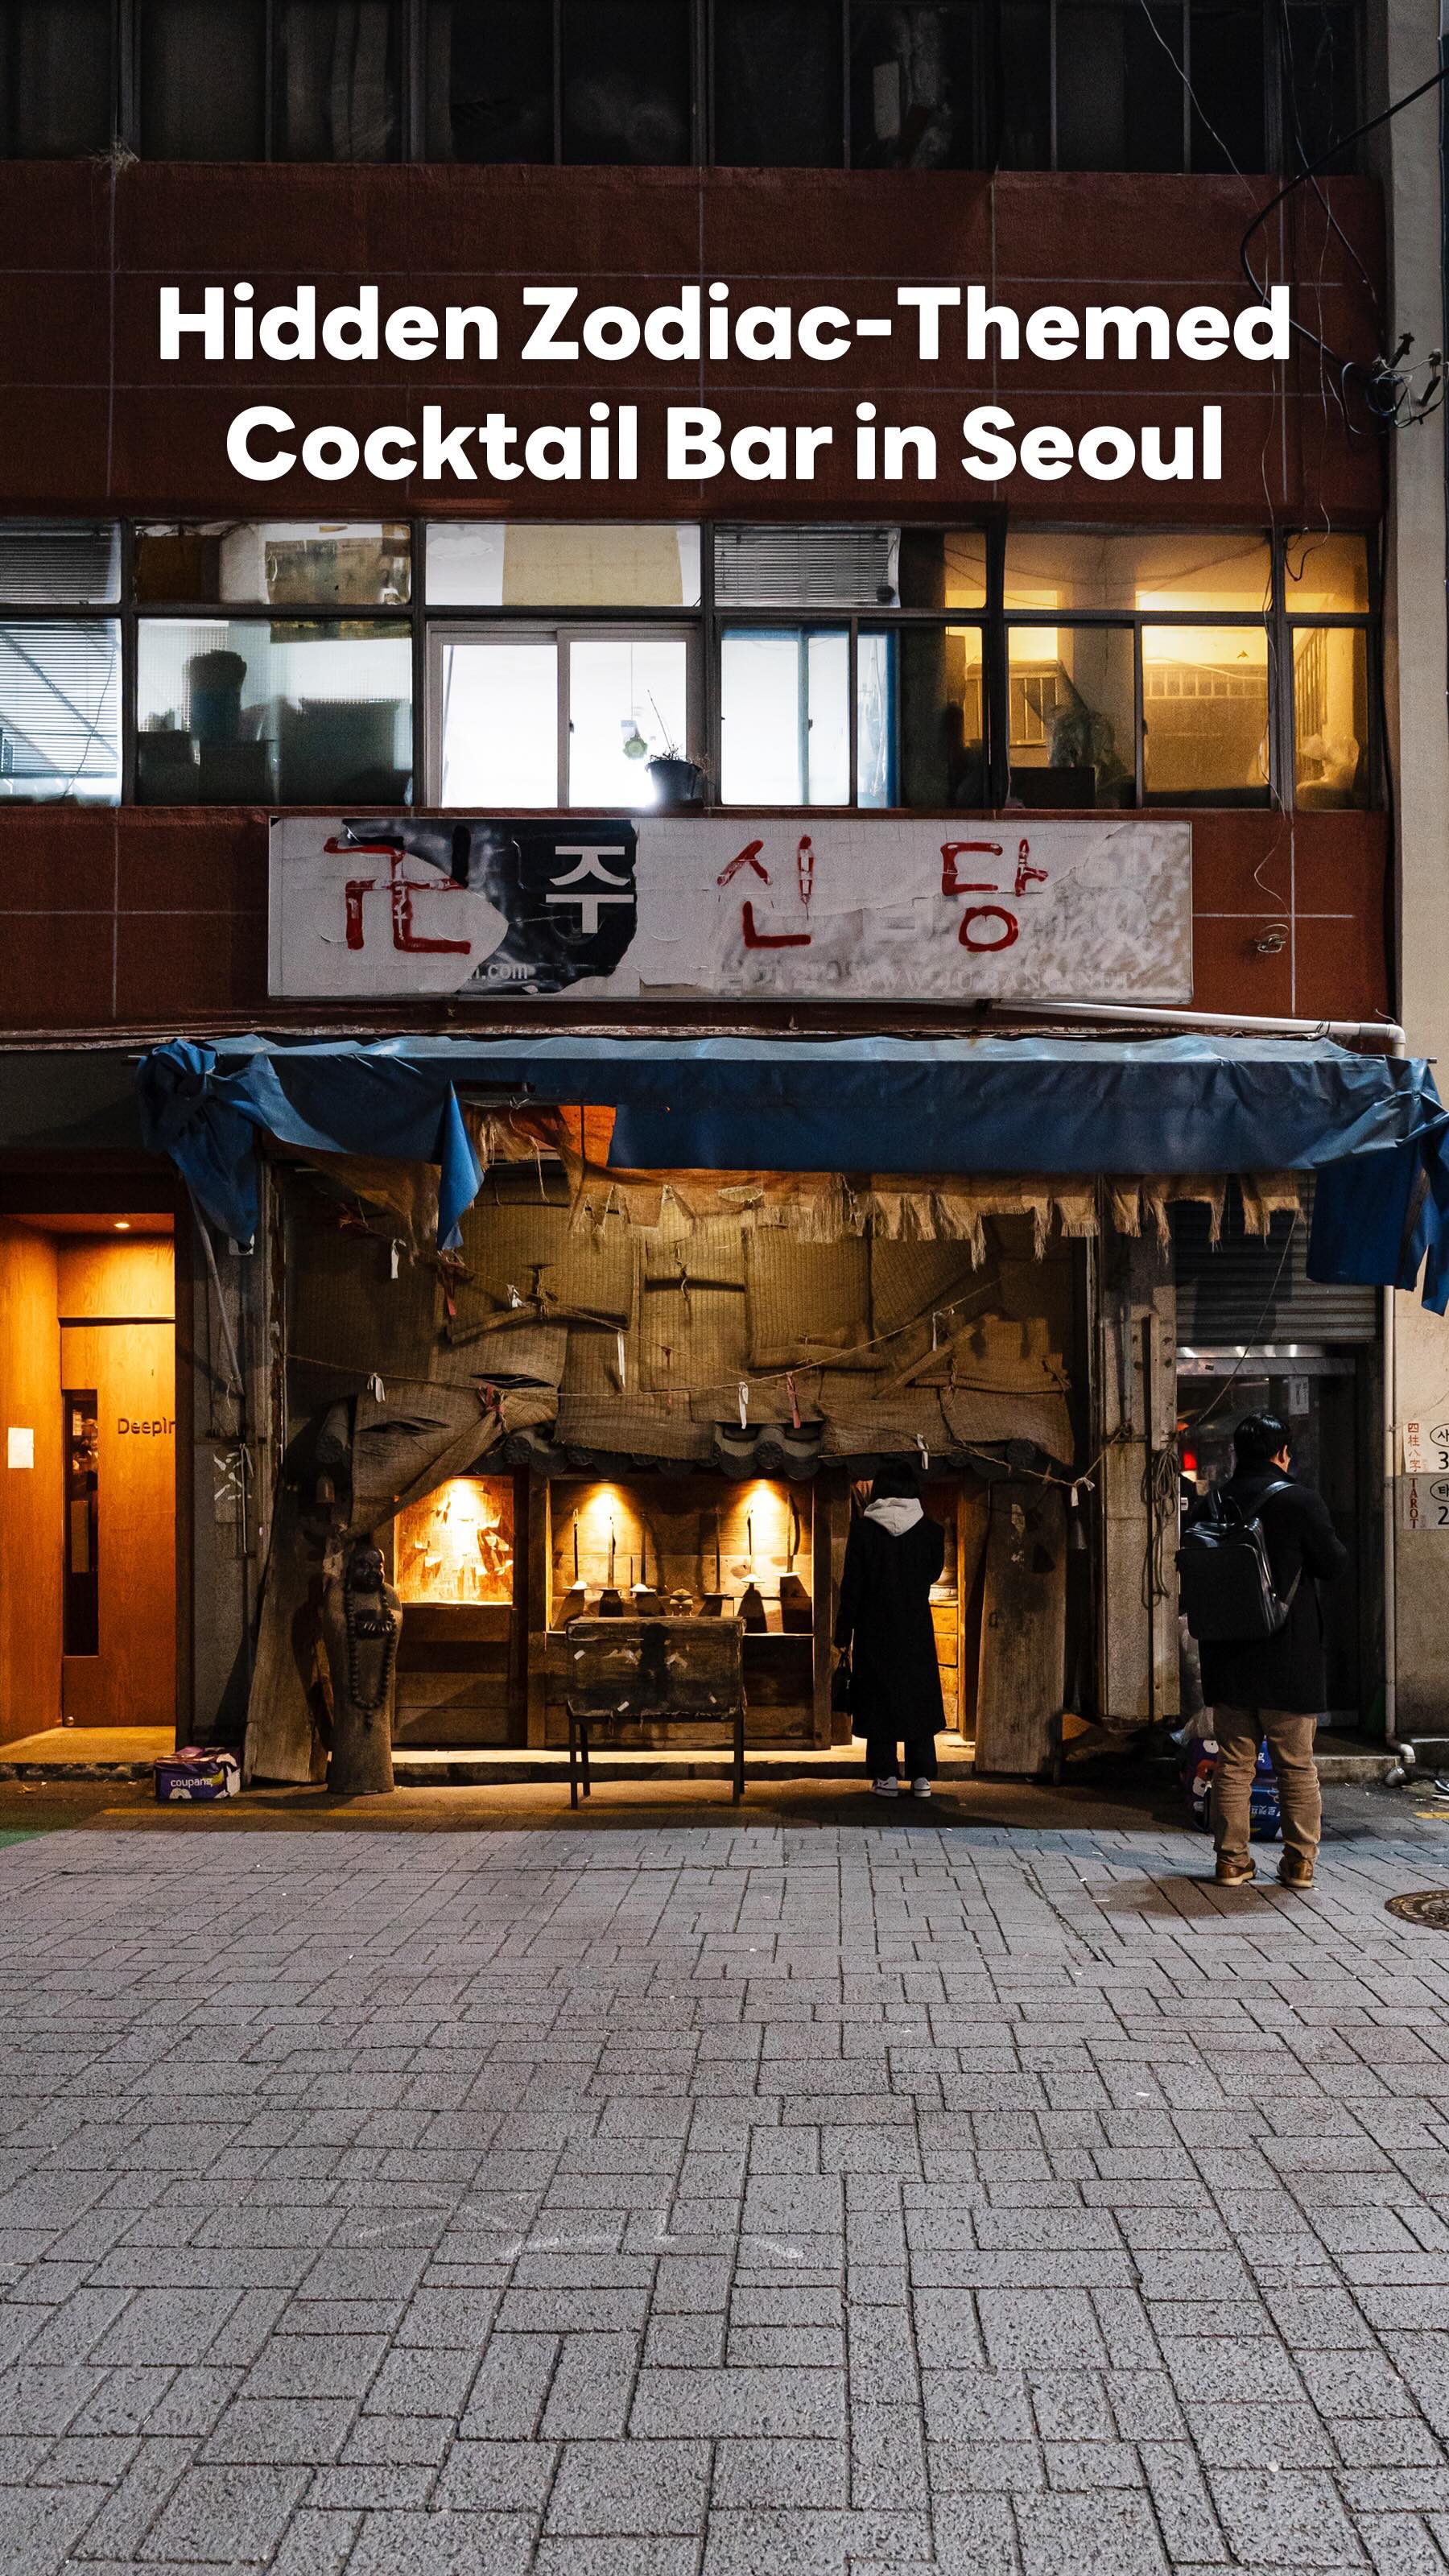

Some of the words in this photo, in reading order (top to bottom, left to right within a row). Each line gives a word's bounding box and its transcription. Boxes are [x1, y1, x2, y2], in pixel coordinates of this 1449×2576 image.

[1408, 1422, 1421, 1472] 四柱八字
[1410, 1478, 1419, 1529] TAROT
[170, 1777, 213, 1788] coupang
